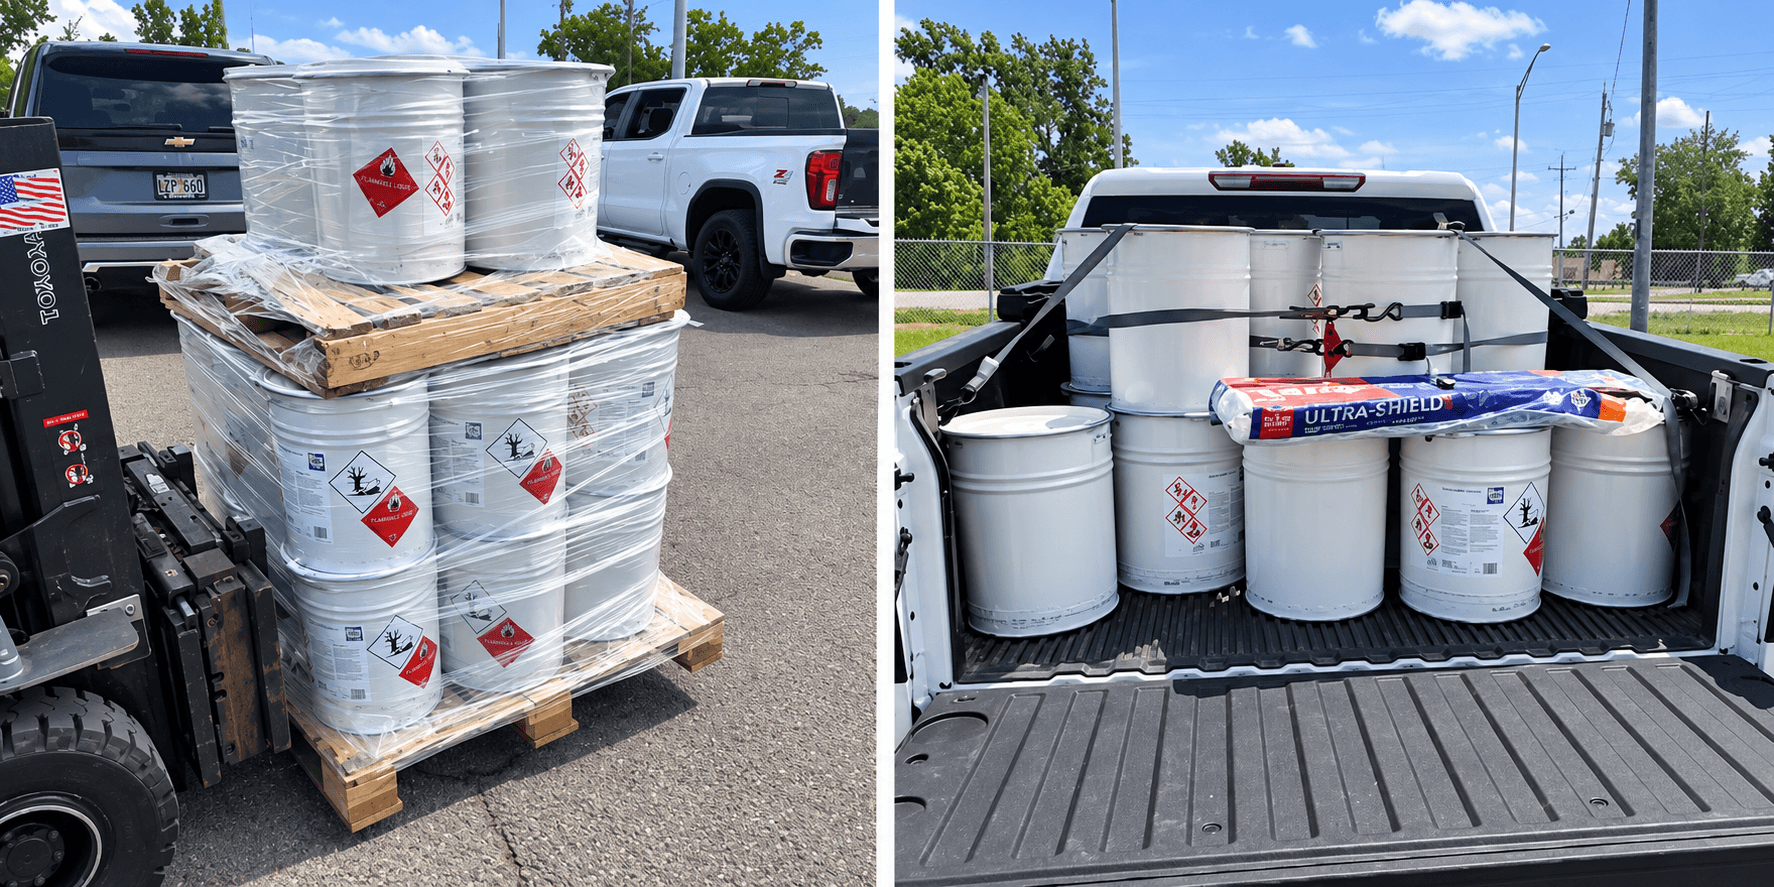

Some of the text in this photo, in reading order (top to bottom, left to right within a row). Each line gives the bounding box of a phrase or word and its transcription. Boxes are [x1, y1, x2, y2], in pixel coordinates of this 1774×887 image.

[158, 179, 203, 193] LZP 660
[1304, 395, 1444, 425] ULTRA-SHIELD
